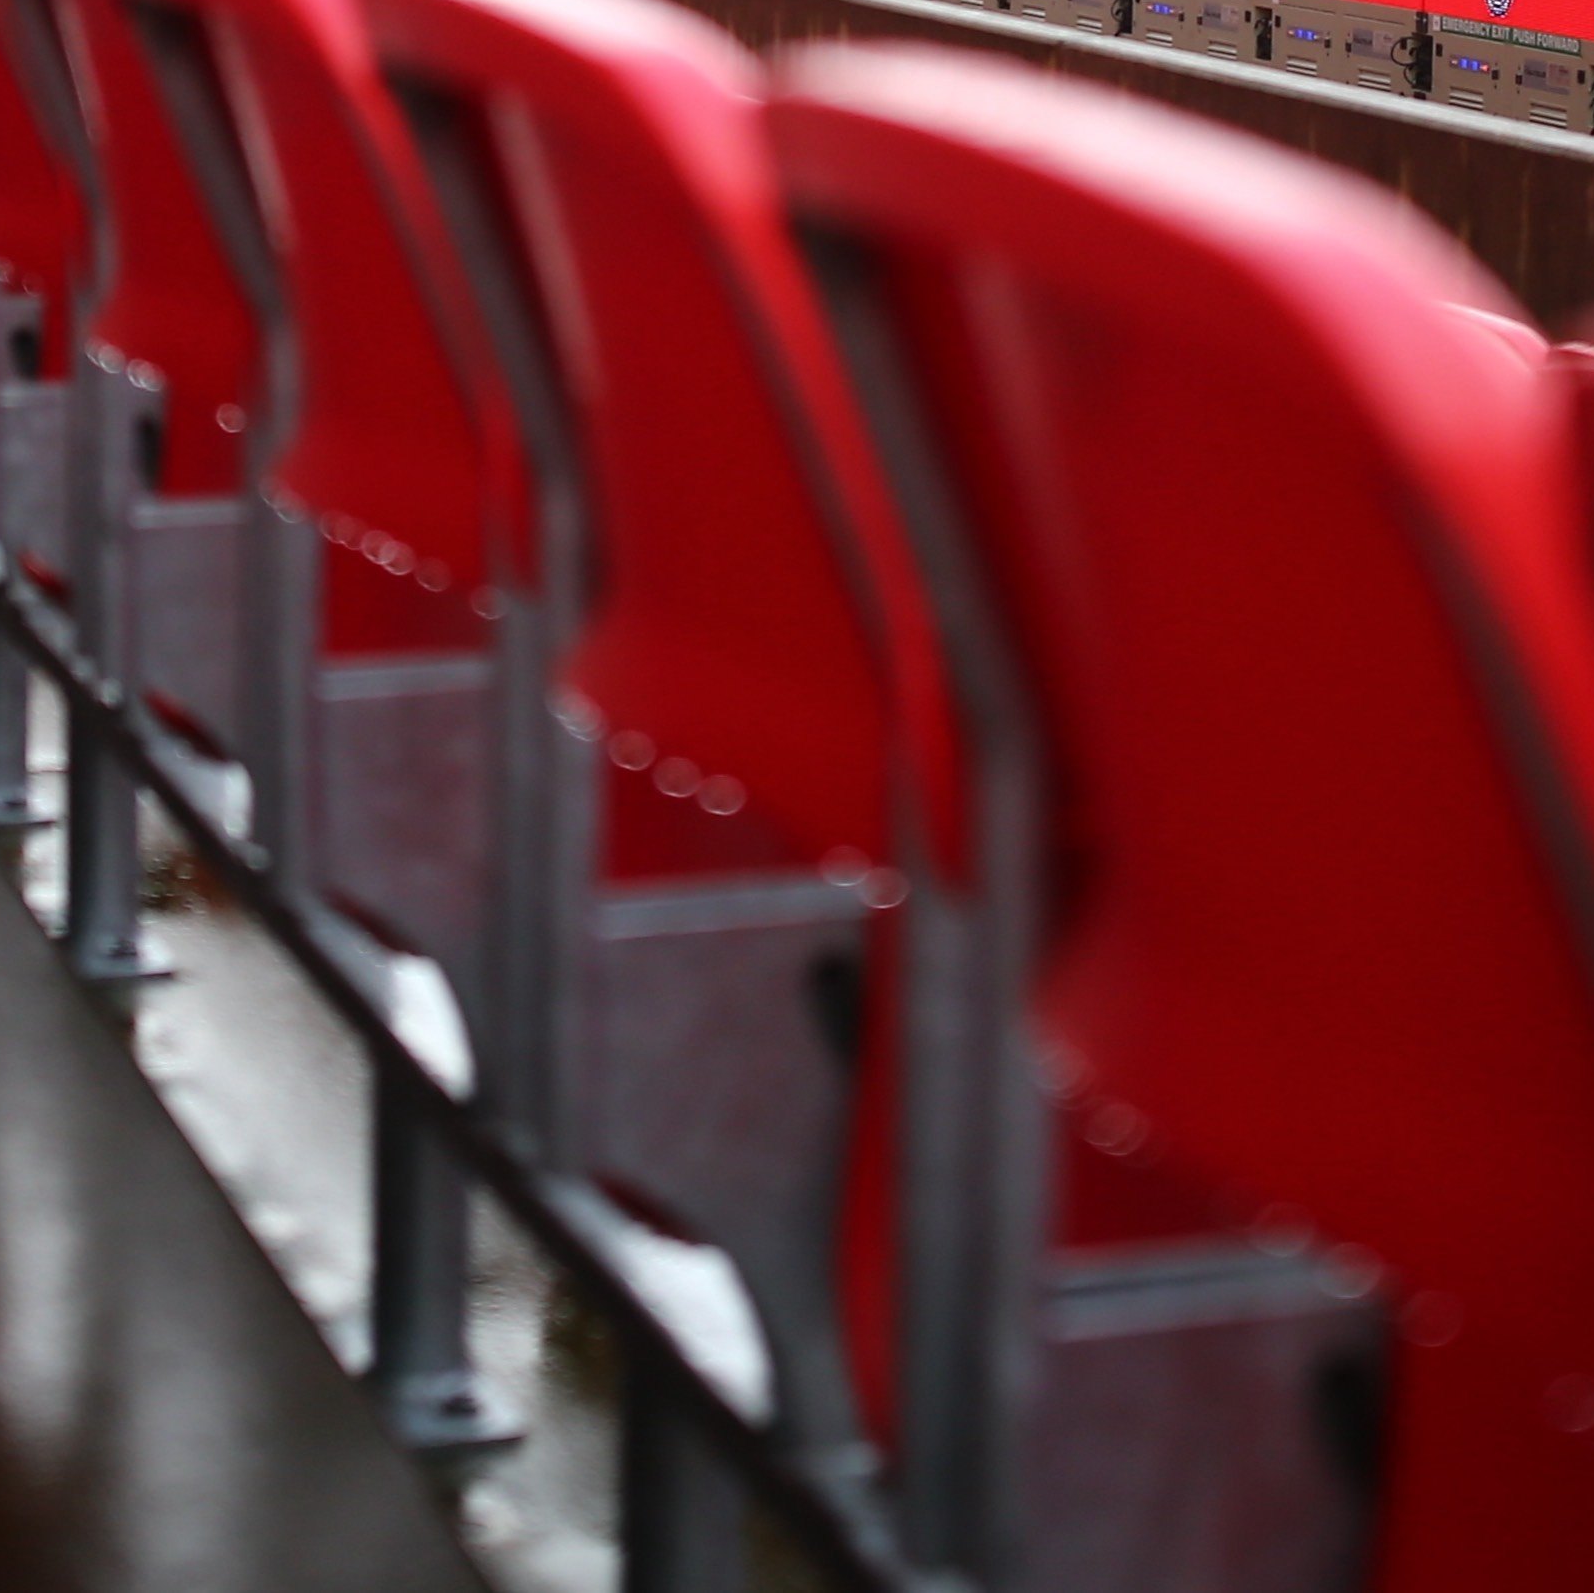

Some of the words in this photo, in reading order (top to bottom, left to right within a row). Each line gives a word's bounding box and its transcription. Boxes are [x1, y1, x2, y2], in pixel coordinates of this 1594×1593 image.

[1442, 17, 1491, 37] EMERGENCY
[1492, 25, 1510, 41] EXIT
[1512, 28, 1536, 45] PUSH
[1537, 33, 1580, 54] FORWARD
